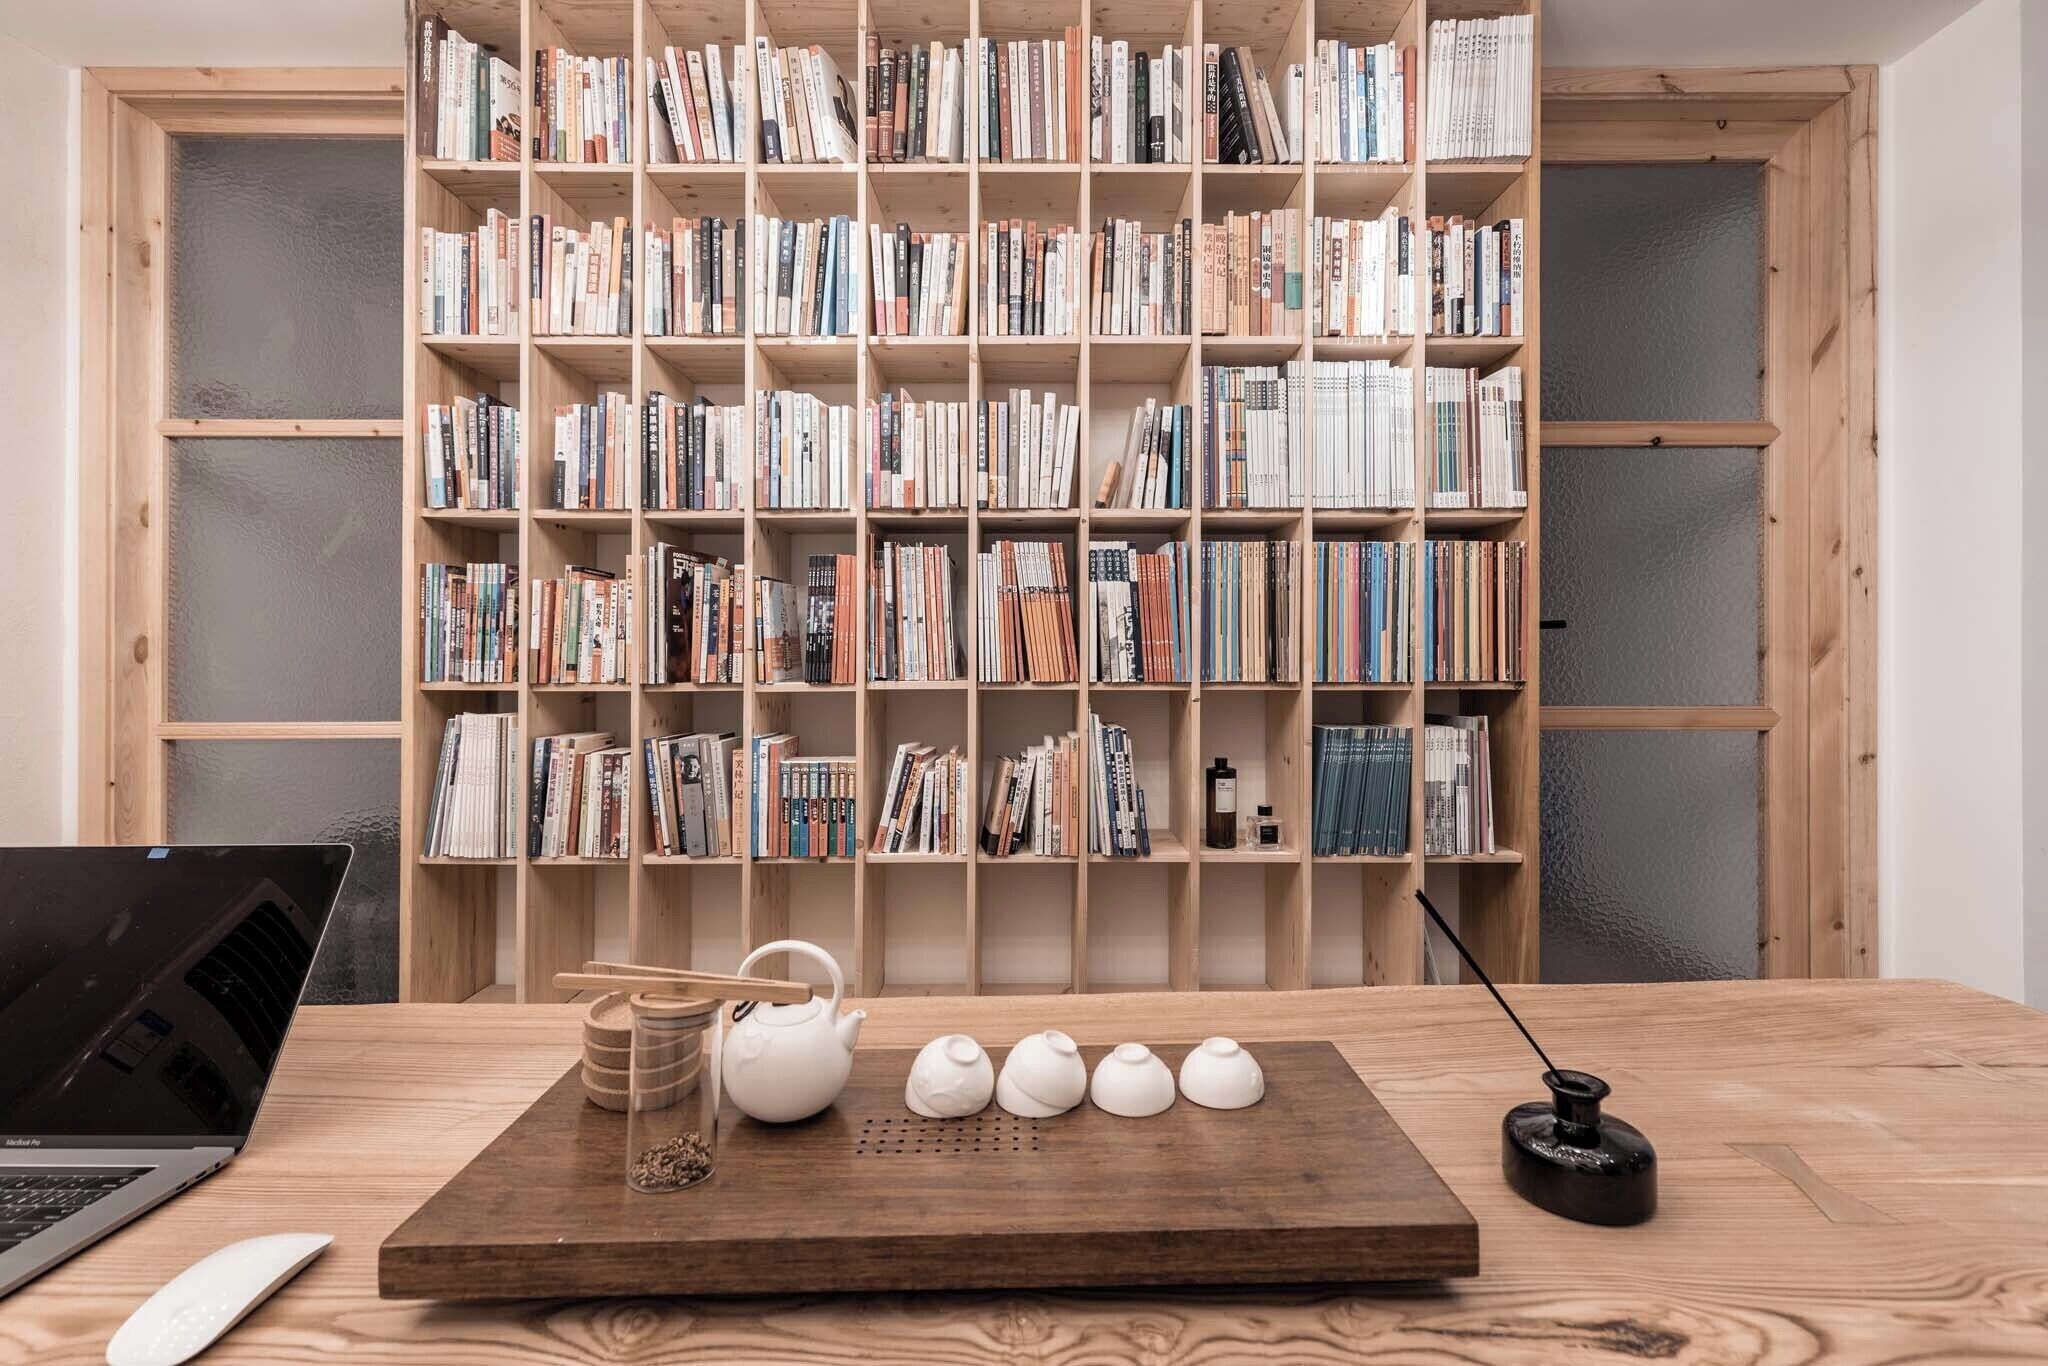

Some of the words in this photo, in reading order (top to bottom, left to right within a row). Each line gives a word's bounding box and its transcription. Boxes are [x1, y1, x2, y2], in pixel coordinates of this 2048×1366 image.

[1207, 64, 1217, 102] 世界是平的
[1203, 232, 1213, 274] 笑林广记
[1512, 233, 1522, 279] 不朽的维纳斯
[649, 408, 658, 451] 厚黑学全集
[734, 759, 744, 800] 笑林广记
[5, 1139, 30, 1147] MacBook
[31, 1139, 41, 1147] Pro
